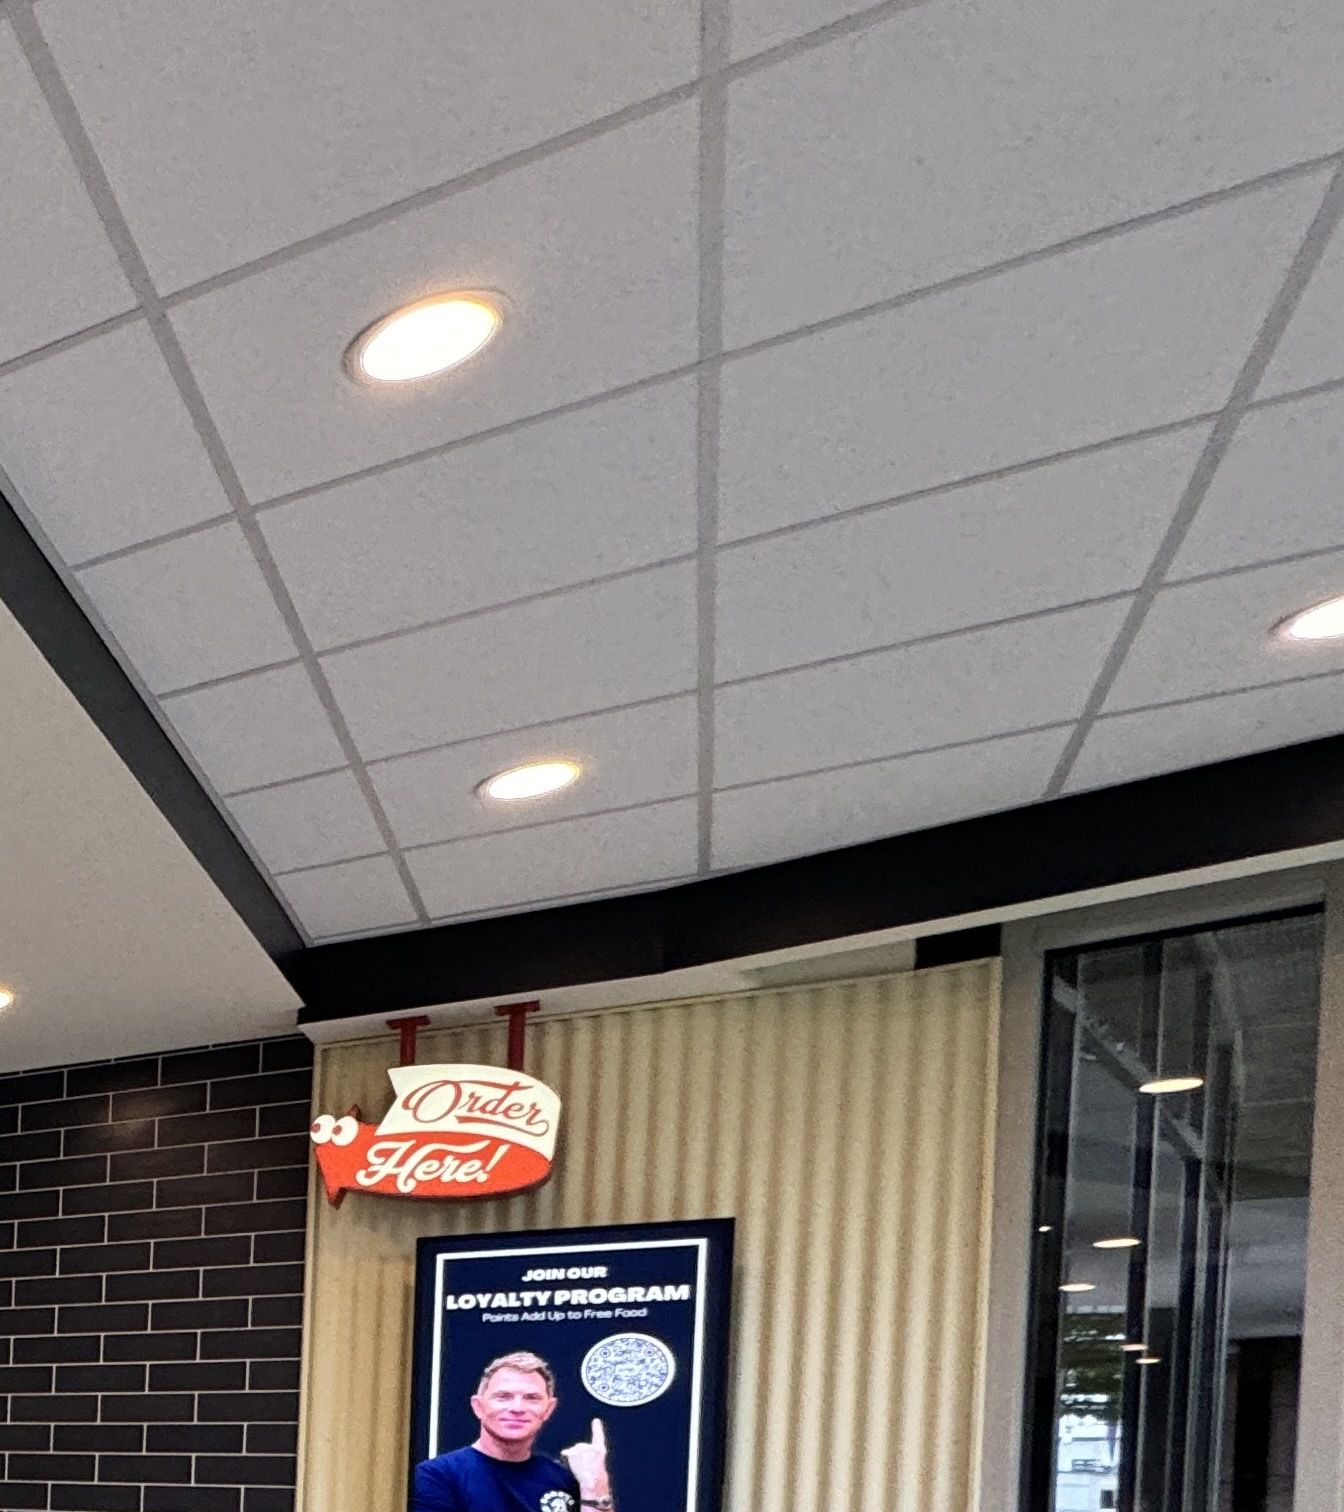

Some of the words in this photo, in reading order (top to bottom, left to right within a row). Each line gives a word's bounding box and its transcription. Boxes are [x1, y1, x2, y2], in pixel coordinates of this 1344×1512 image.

[401, 1080, 550, 1137] Order
[355, 1139, 511, 1194] Here!
[521, 1268, 566, 1282] JOIN
[567, 1266, 609, 1279] OUR
[446, 1290, 552, 1310] LOYALTY
[554, 1284, 691, 1305] PROGRAM
[482, 1311, 519, 1323] Points
[521, 1310, 546, 1321] Add
[547, 1310, 565, 1323] Up
[567, 1310, 582, 1320] to
[584, 1309, 613, 1319] Free
[614, 1307, 649, 1319] Food
